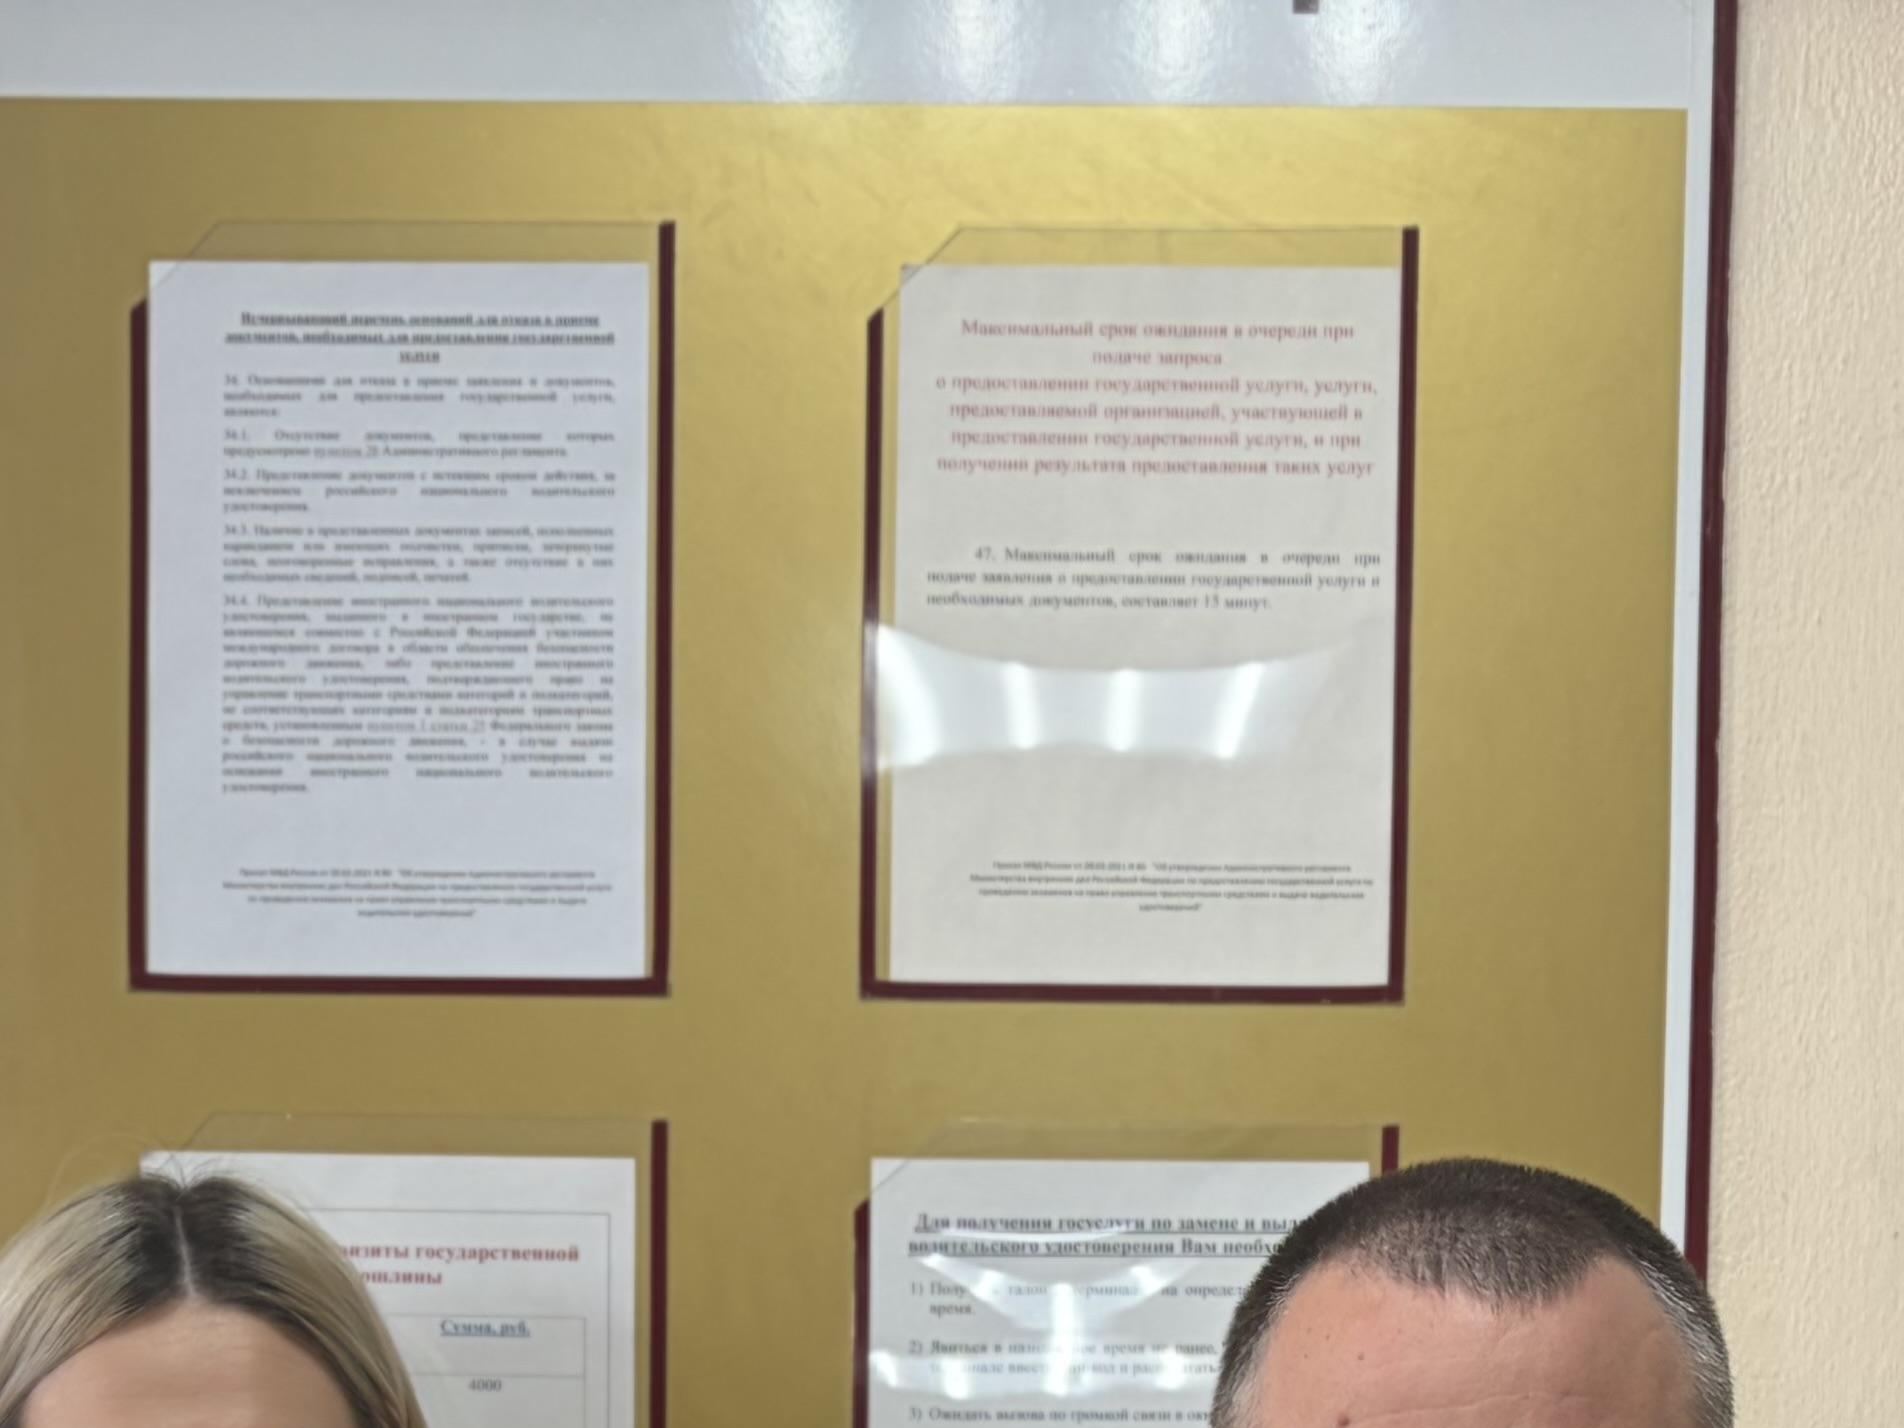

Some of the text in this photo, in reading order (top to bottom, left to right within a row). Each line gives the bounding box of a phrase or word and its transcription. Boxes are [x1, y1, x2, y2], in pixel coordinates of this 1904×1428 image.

[914, 1213, 1257, 1235] Для получения госуслуги по замене и
[415, 1244, 580, 1264] государственной
[908, 1241, 1040, 1257] водительского
[1044, 1241, 1176, 1258] удостоверения
[1182, 1240, 1217, 1254] Вам
[467, 1377, 503, 1393] 4000
